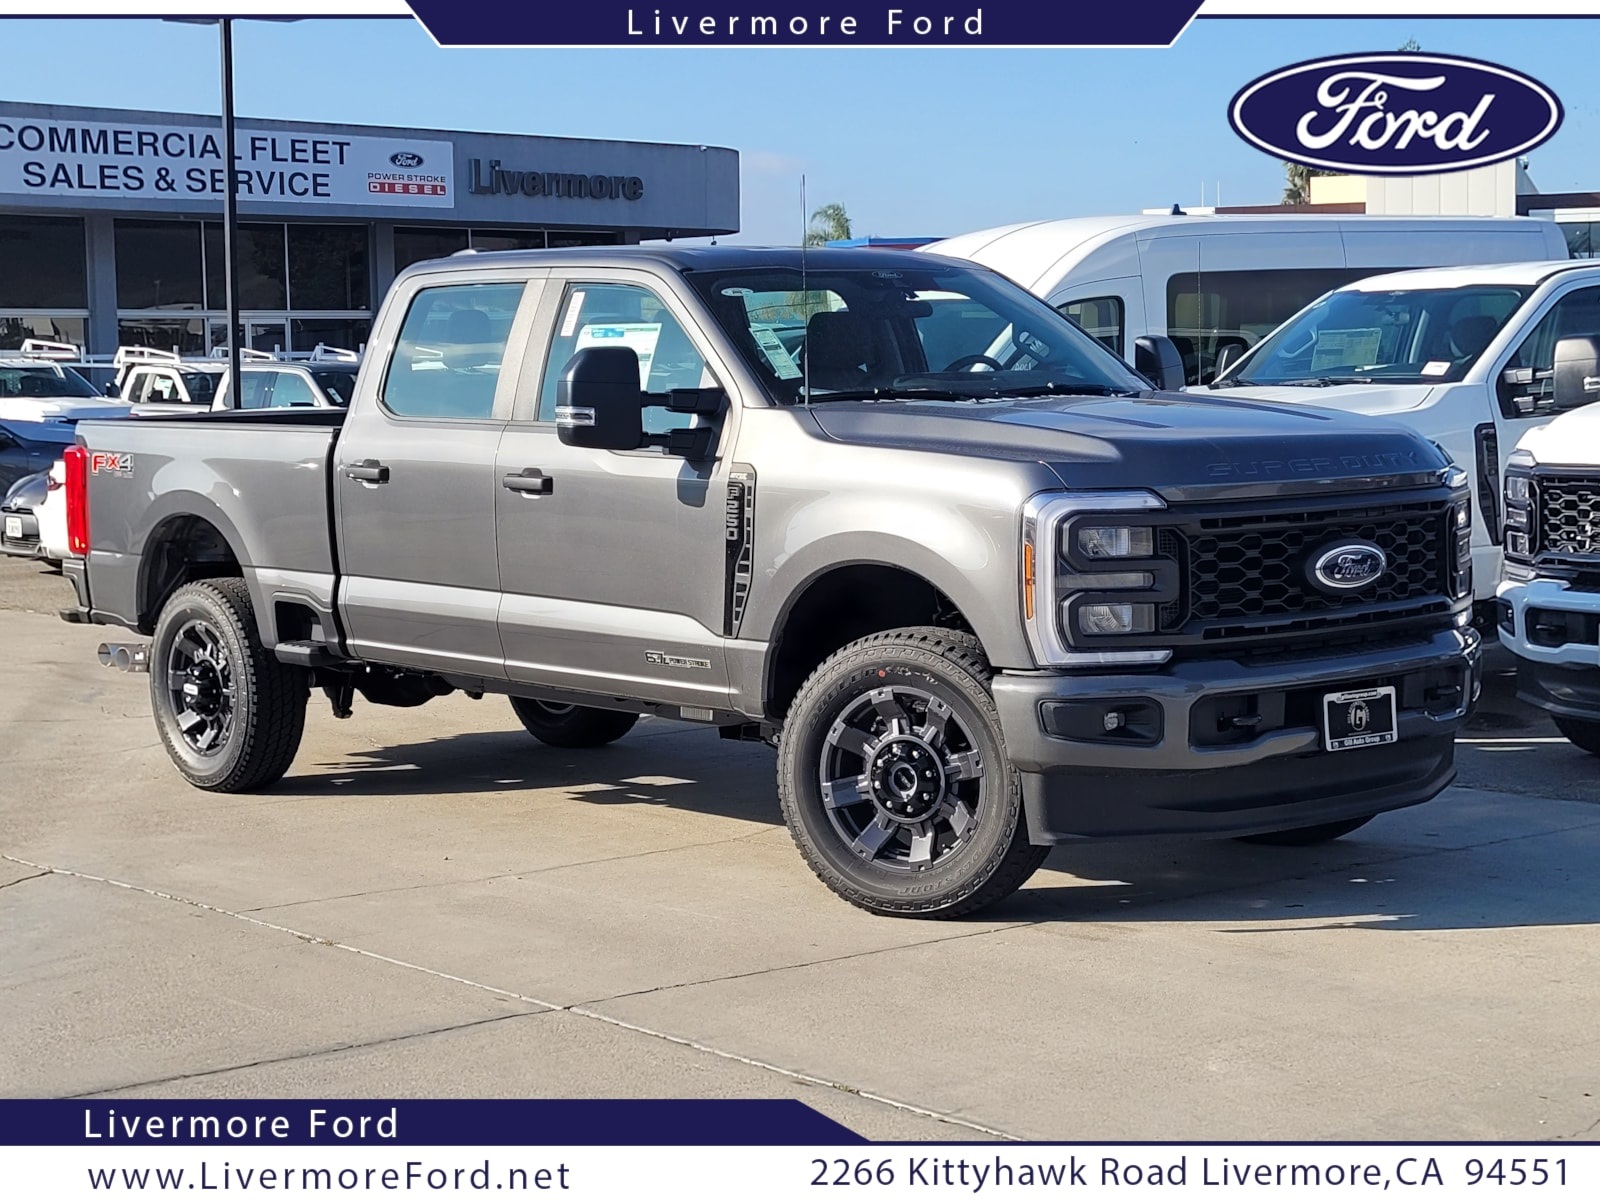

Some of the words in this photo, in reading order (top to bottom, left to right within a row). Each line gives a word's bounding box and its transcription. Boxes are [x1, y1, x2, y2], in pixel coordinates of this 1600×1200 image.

[250, 136, 351, 166] FLEET
[395, 152, 419, 167] Ford
[22, 160, 145, 191] SALES
[153, 166, 178, 193] &
[185, 167, 332, 198] SERVICE
[367, 172, 405, 181] POWER
[406, 174, 447, 183] STROKE
[369, 182, 446, 195] DIESEL
[469, 158, 644, 201] Livermore
[92, 452, 135, 474] FX4
[1207, 457, 1336, 477] SUPER
[1339, 451, 1418, 469] DUTY
[1334, 554, 1372, 579] Ford
